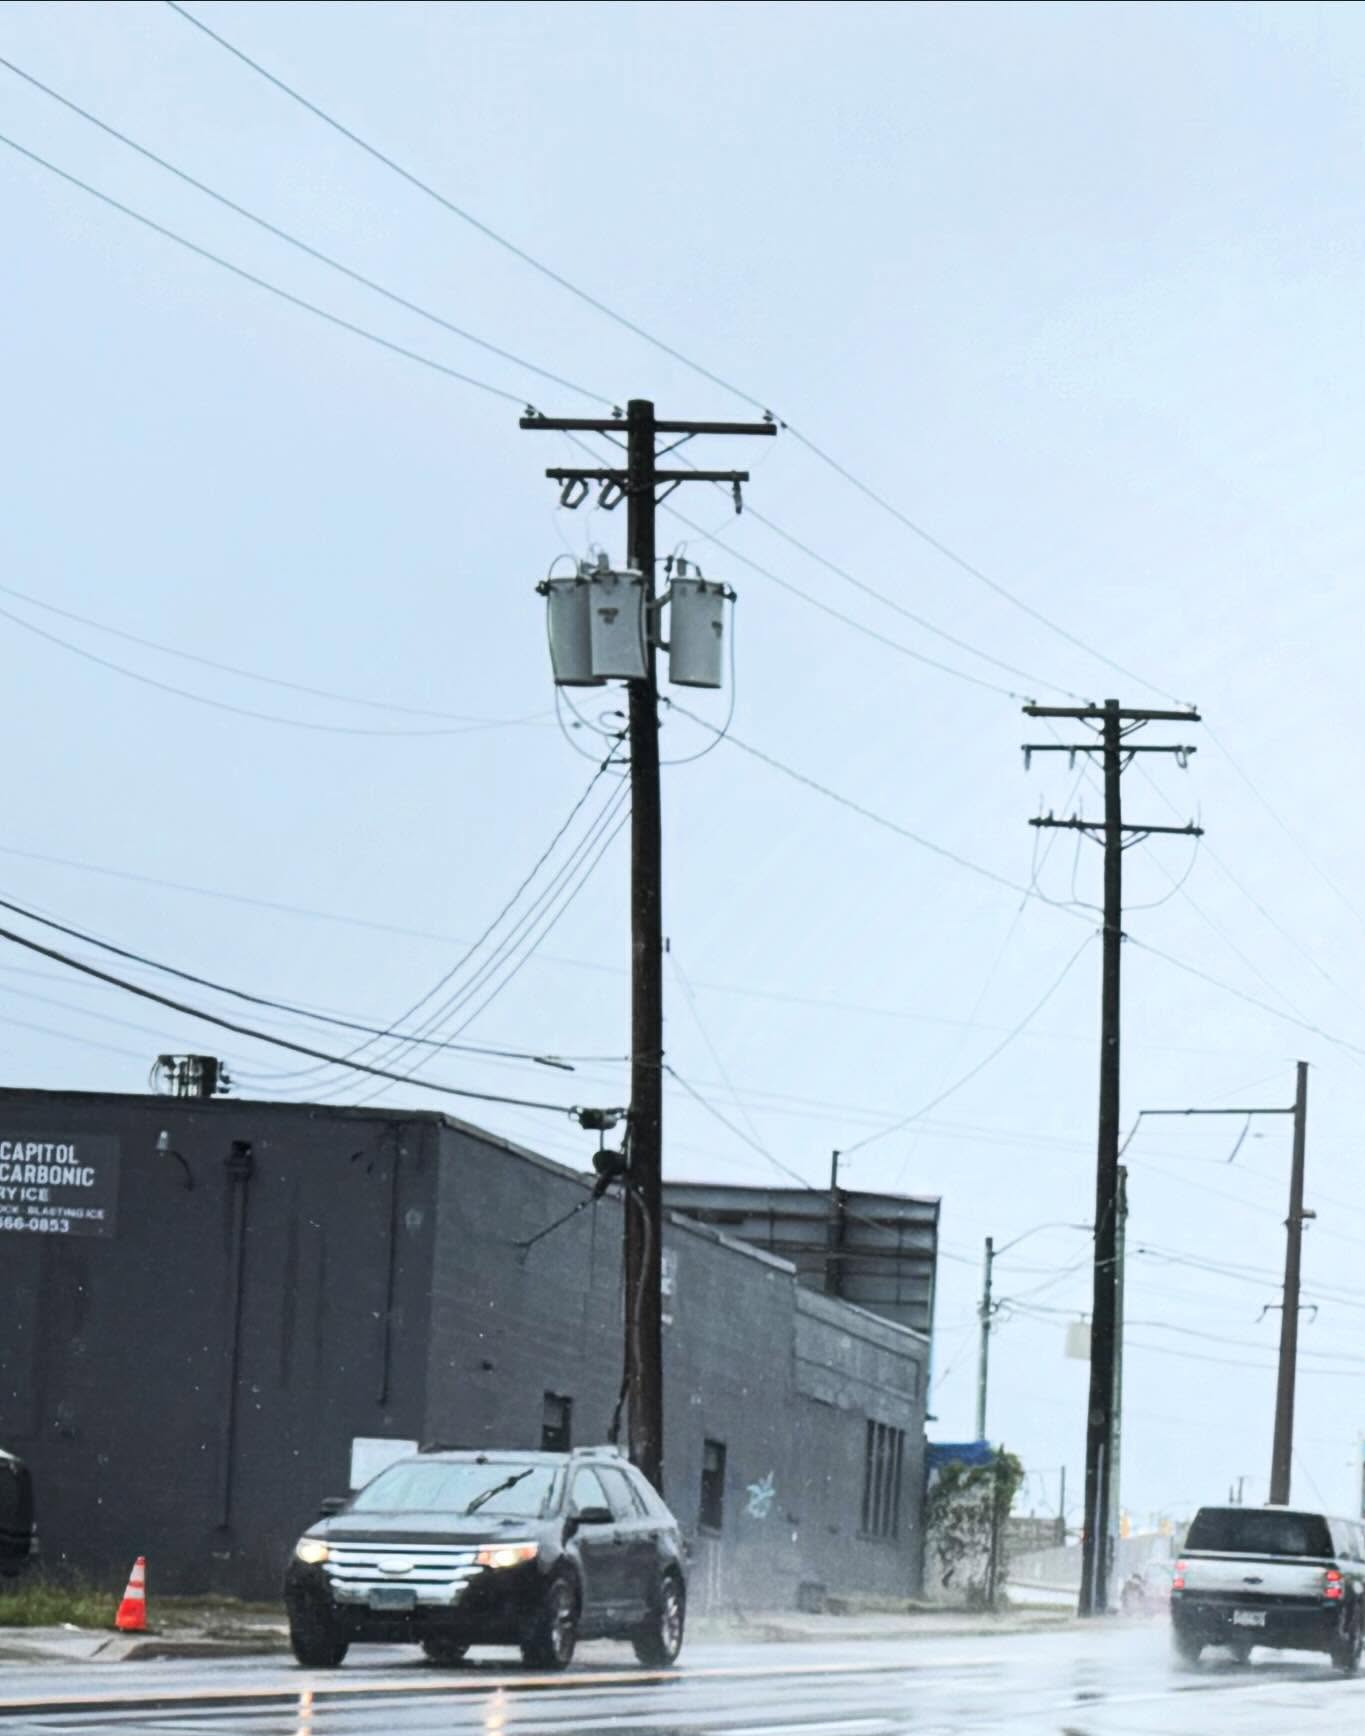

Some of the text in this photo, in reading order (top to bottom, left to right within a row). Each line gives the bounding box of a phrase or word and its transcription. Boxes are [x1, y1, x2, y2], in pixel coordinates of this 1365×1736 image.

[0, 1141, 79, 1165] CAPITOL
[0, 1162, 95, 1187] CARBONIC
[20, 1187, 49, 1203] ICE
